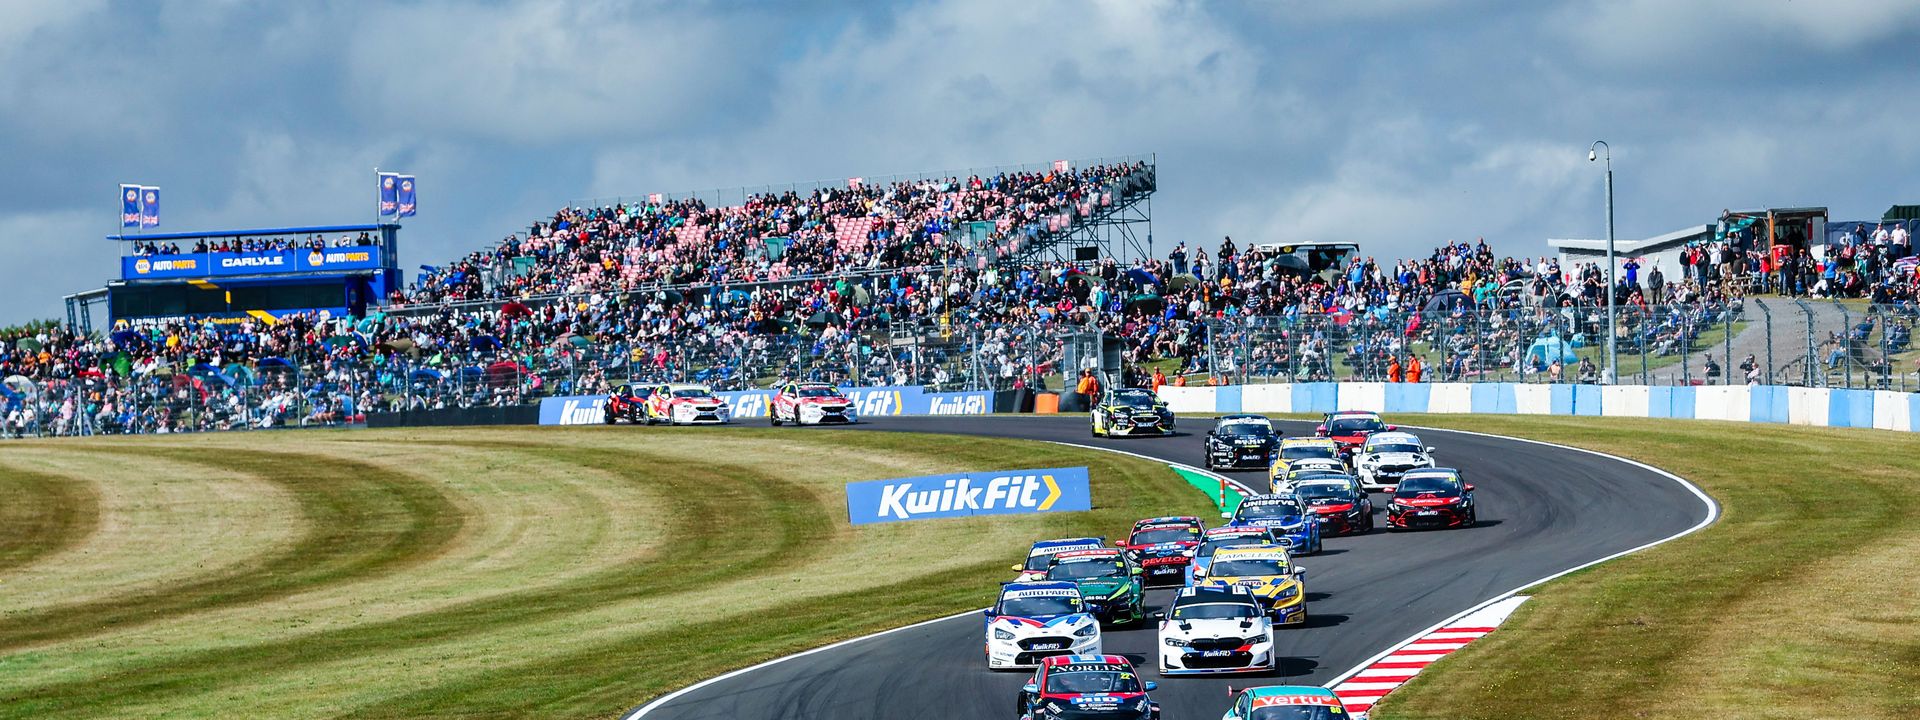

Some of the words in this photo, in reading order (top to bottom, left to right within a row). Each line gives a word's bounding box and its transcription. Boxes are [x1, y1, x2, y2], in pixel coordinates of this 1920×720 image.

[222, 256, 283, 268] CARLYLE
[1216, 552, 1283, 560] CATACLEAN
[1055, 664, 1123, 672] NORLIN
